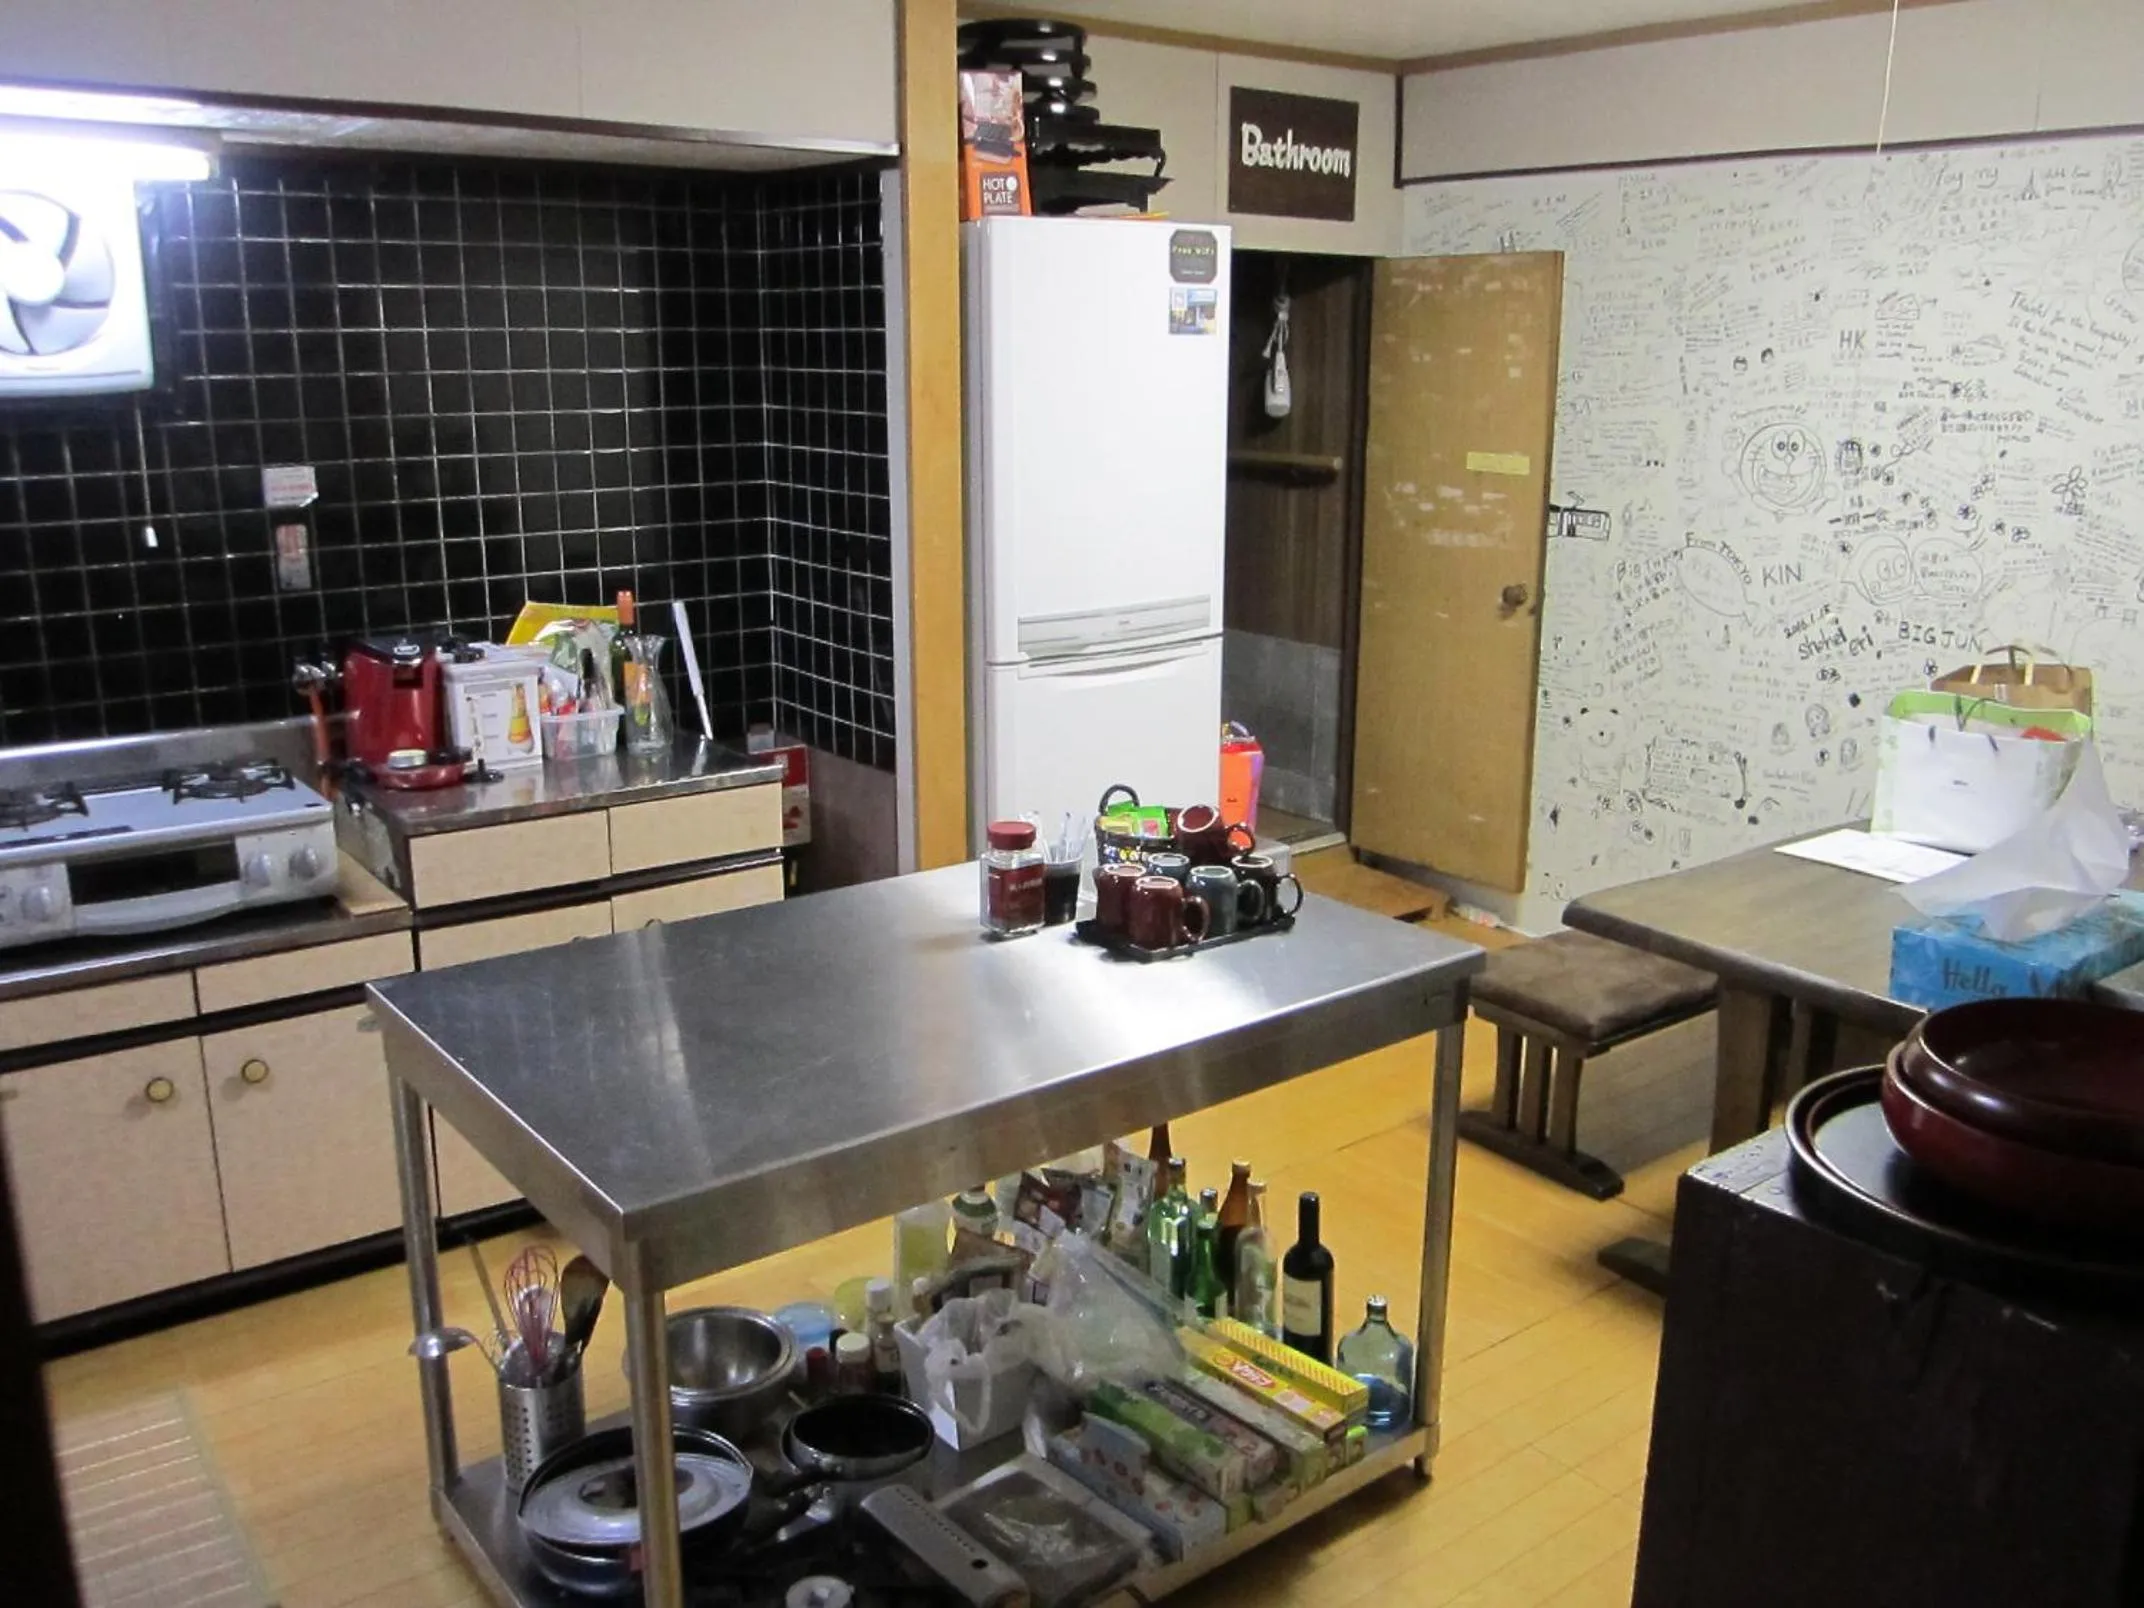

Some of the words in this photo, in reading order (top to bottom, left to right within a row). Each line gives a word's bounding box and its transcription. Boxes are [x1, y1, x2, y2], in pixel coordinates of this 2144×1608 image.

[1241, 122, 1351, 178] Bathroom
[983, 176, 1005, 190] HOT
[983, 191, 1013, 204] PLATE
[1839, 329, 1867, 351] HK
[1762, 562, 1803, 589] KIN
[1899, 621, 1937, 645] BIG
[1940, 629, 1984, 654] JUN
[1943, 957, 2009, 997] Hello
